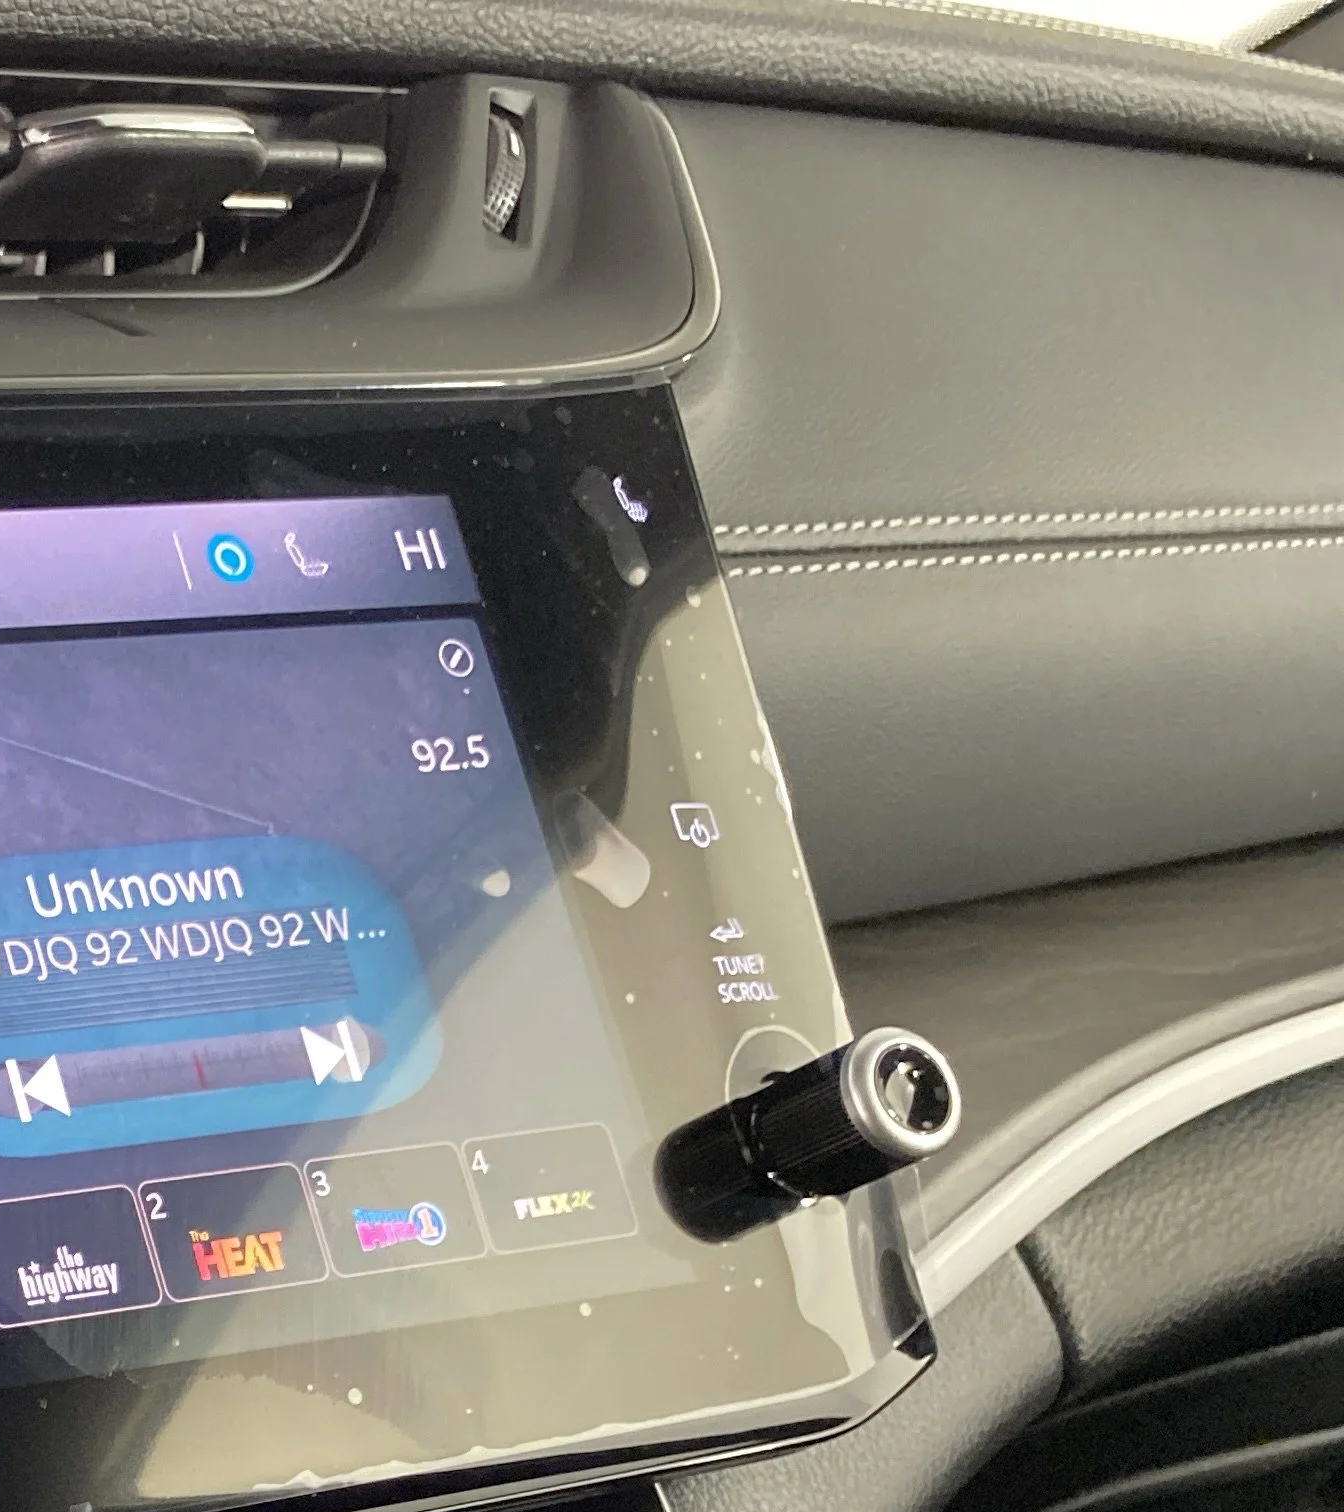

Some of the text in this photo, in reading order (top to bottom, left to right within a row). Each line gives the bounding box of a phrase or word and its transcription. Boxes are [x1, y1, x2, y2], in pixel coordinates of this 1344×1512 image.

[394, 528, 448, 573] HI
[410, 733, 492, 775] 92.5
[26, 865, 244, 919] Unknown
[86, 928, 139, 968] 92
[141, 918, 255, 963] WDJQ
[259, 911, 311, 950] 92
[718, 979, 780, 1003] SCROLL
[311, 1170, 331, 1197] 3
[470, 1149, 489, 1176] 4
[145, 1192, 168, 1221] 2
[56, 1246, 85, 1267] the
[193, 1231, 286, 1281] HEAT
[18, 1261, 119, 1303] highway
